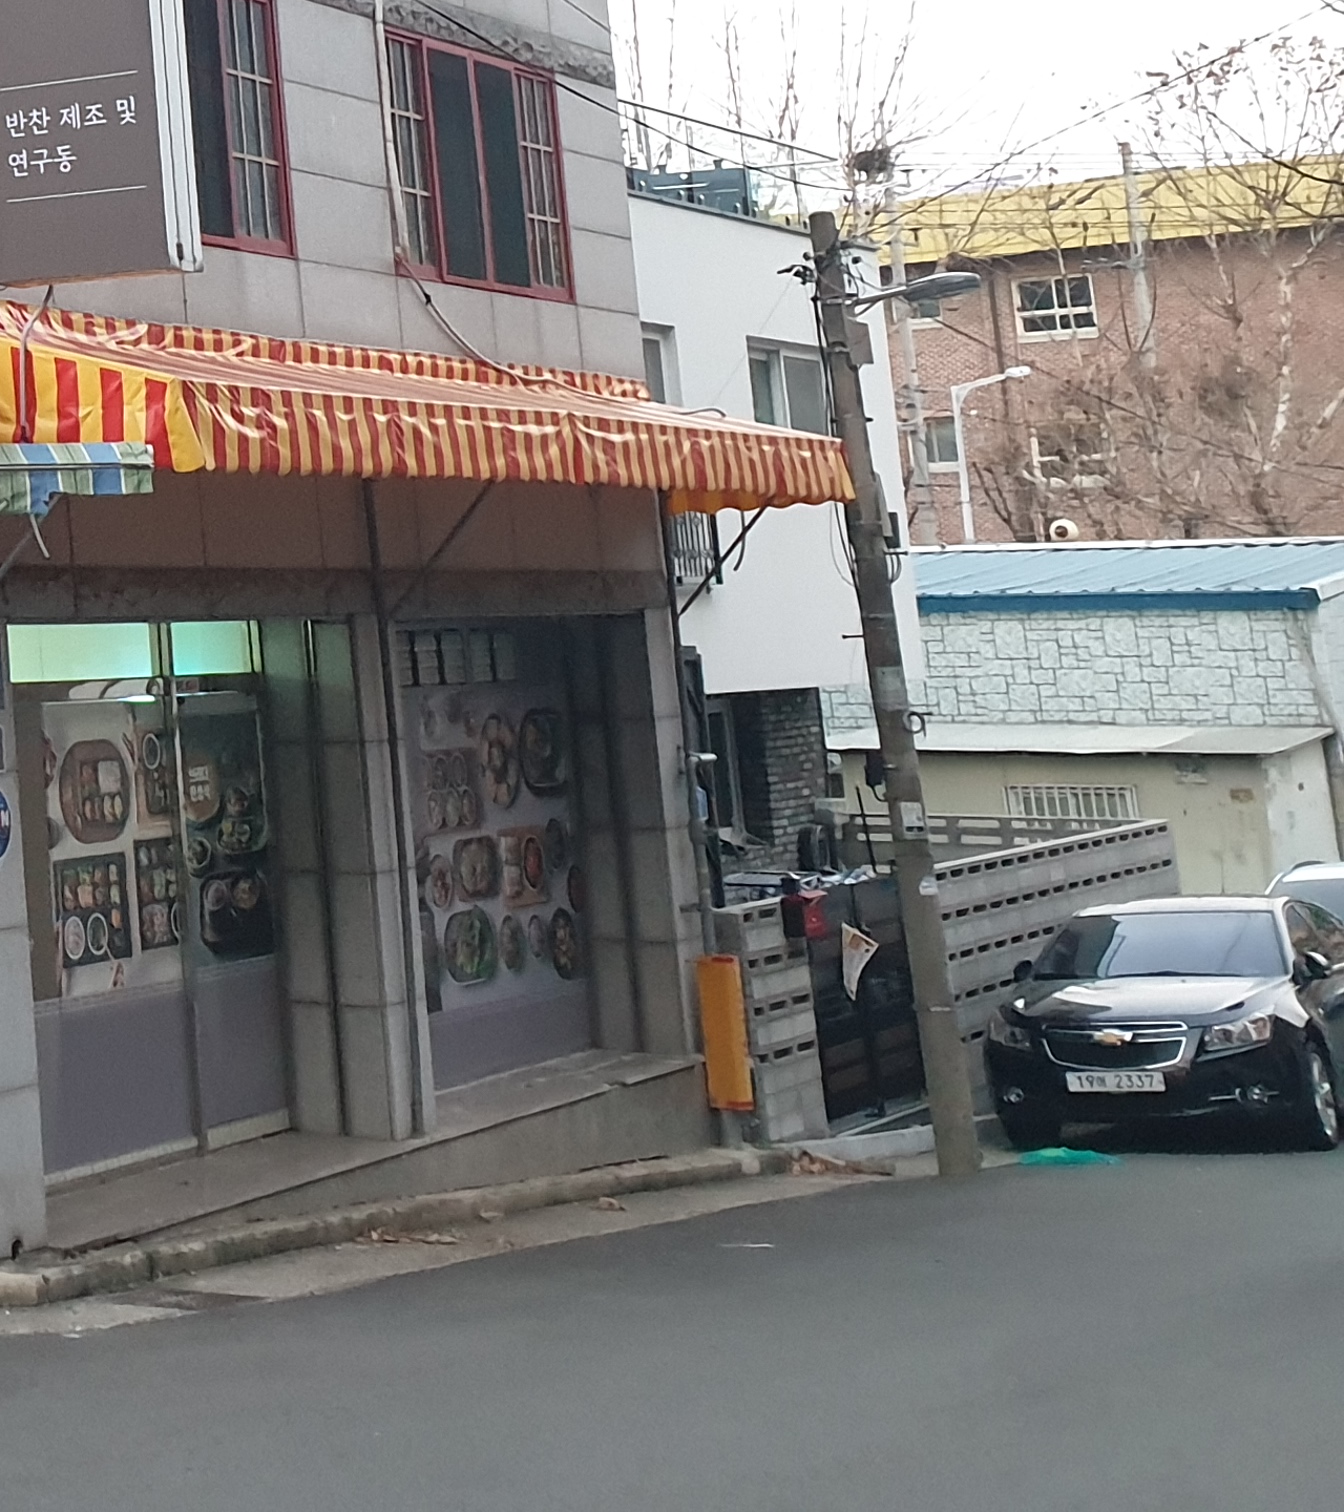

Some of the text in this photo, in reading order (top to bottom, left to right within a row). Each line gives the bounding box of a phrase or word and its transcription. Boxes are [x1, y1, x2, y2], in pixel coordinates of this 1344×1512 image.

[5, 95, 137, 138] 반찬 제조 및
[8, 144, 77, 177] 연구동
[1113, 1074, 1154, 1089] 2337
